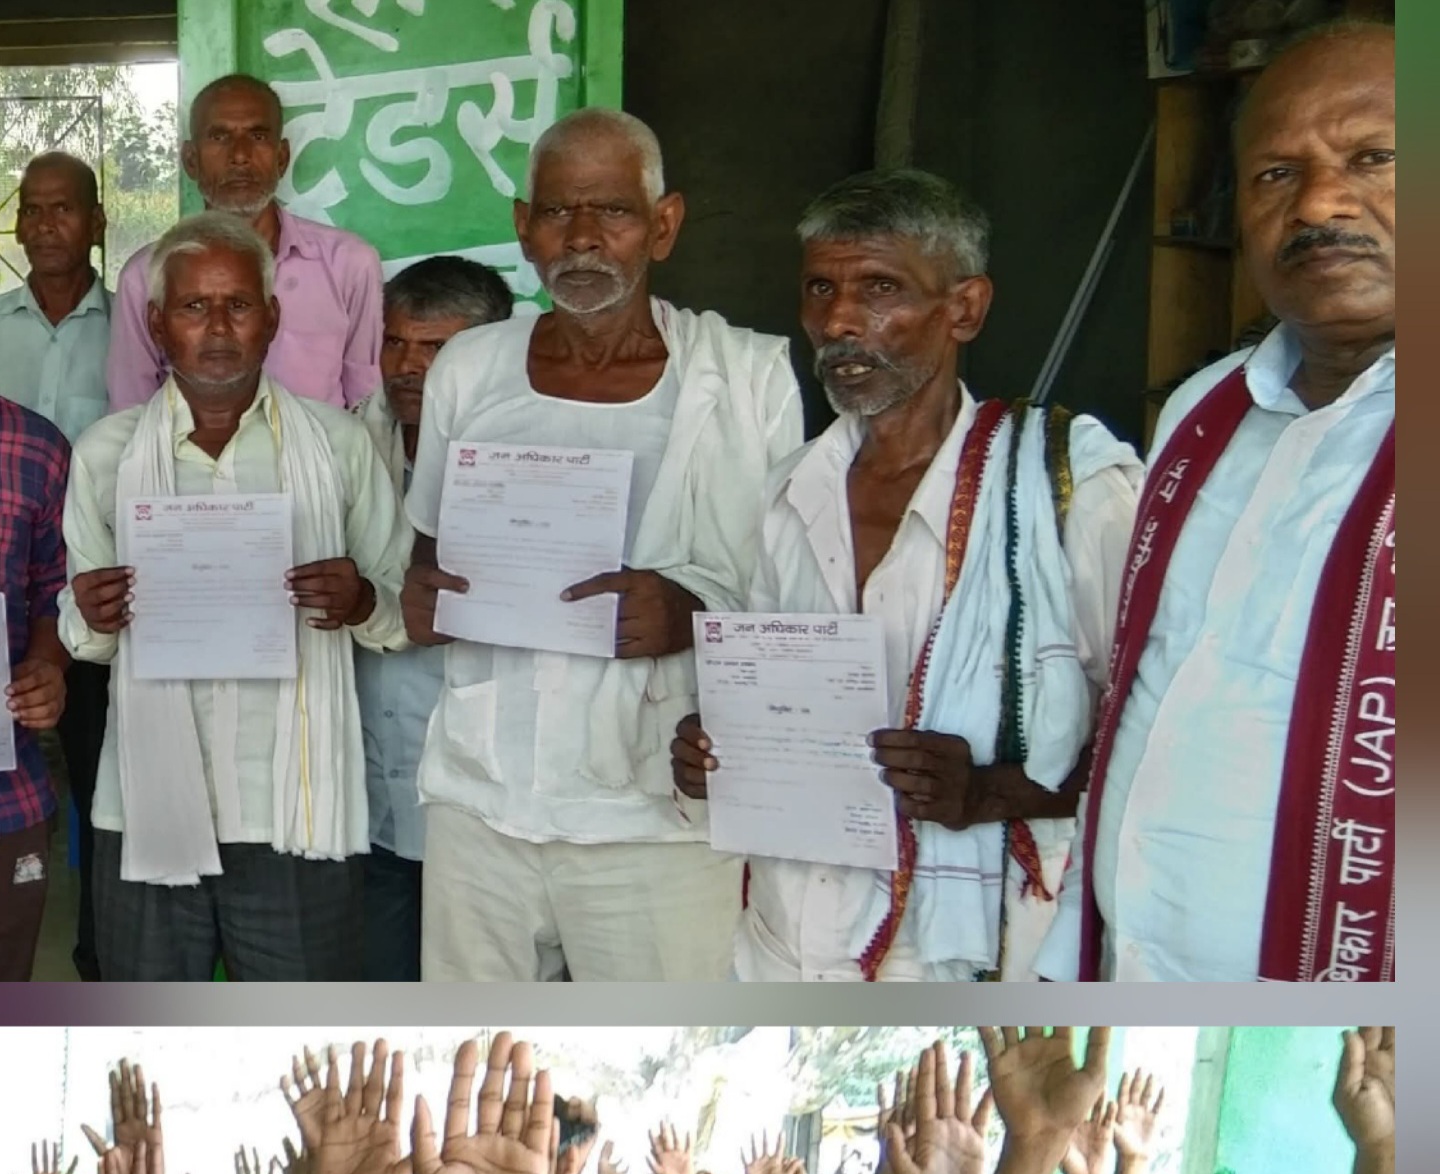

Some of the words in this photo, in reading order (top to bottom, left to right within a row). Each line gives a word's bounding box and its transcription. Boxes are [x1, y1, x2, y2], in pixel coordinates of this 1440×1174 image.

[734, 622, 755, 634] जन
[760, 619, 809, 635] अधिकार
[812, 621, 839, 636] पार्टी
[1342, 677, 1395, 797] (JAP)
[1332, 818, 1388, 885] पार्टी
